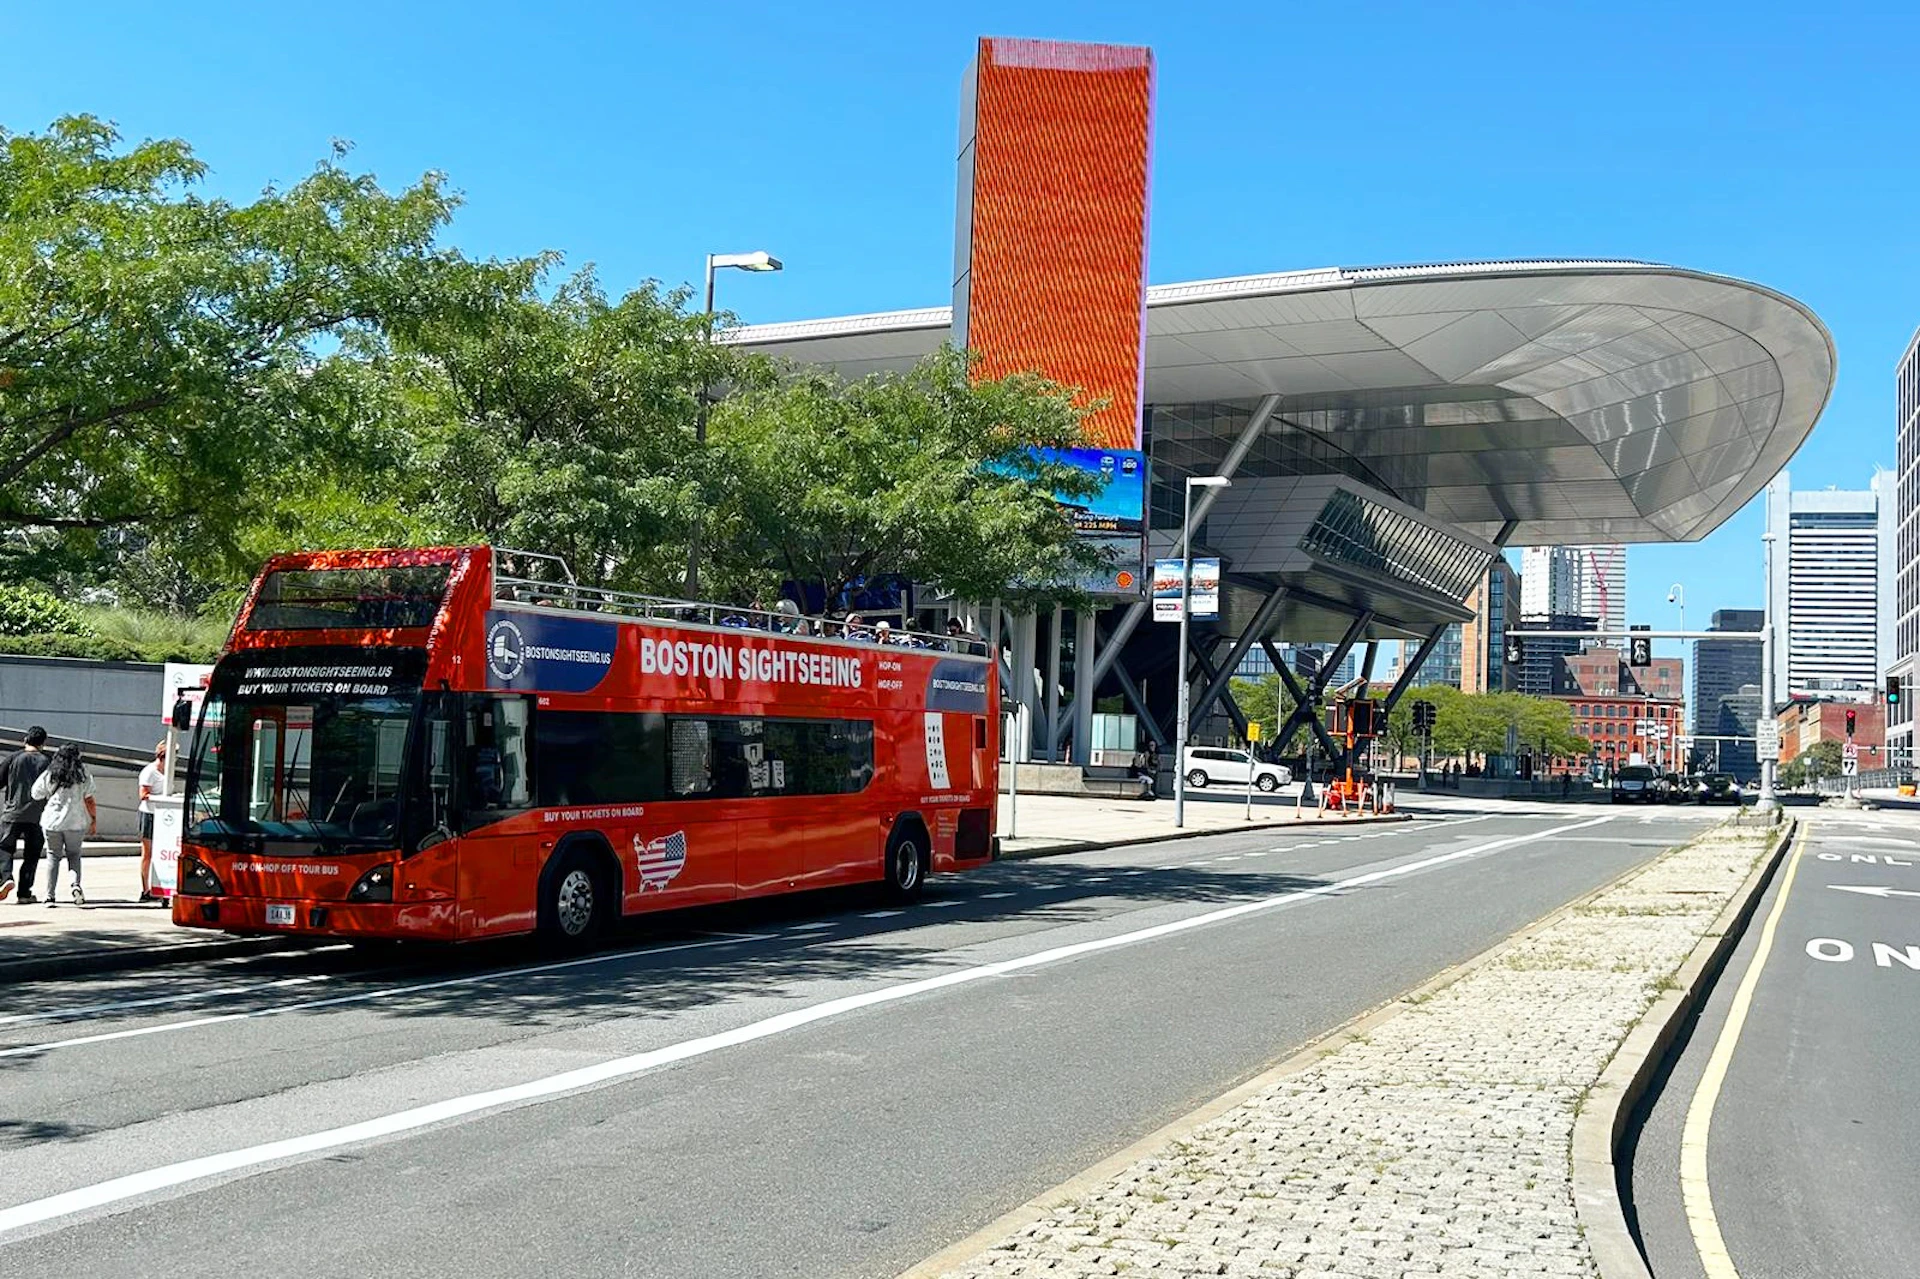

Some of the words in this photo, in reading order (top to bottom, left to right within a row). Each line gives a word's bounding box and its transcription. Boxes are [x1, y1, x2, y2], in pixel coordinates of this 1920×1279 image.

[452, 655, 462, 665] 12
[525, 645, 612, 665] BOSTONSIGHTSEEING.US
[640, 637, 733, 680] BOSTON
[738, 647, 862, 689] SIGHTSEEING
[879, 661, 902, 671] HOP-ON
[245, 666, 393, 678] WWW.BOSTONSIGHTSEEING.US
[237, 684, 260, 695] BUY
[261, 683, 288, 694] YOUR
[291, 682, 333, 693] TICKETS
[334, 682, 350, 693] ON
[352, 684, 388, 695] BOARD
[877, 680, 903, 690] HOP-OFF
[544, 811, 559, 822] BUY
[561, 810, 580, 821] YOUR
[581, 808, 610, 819] TICKETS
[611, 807, 621, 817] ON
[622, 806, 644, 816] BOARD
[232, 862, 248, 872] HOP
[281, 864, 296, 873] OFF
[298, 864, 320, 874] TOUR
[321, 865, 339, 875] BUS
